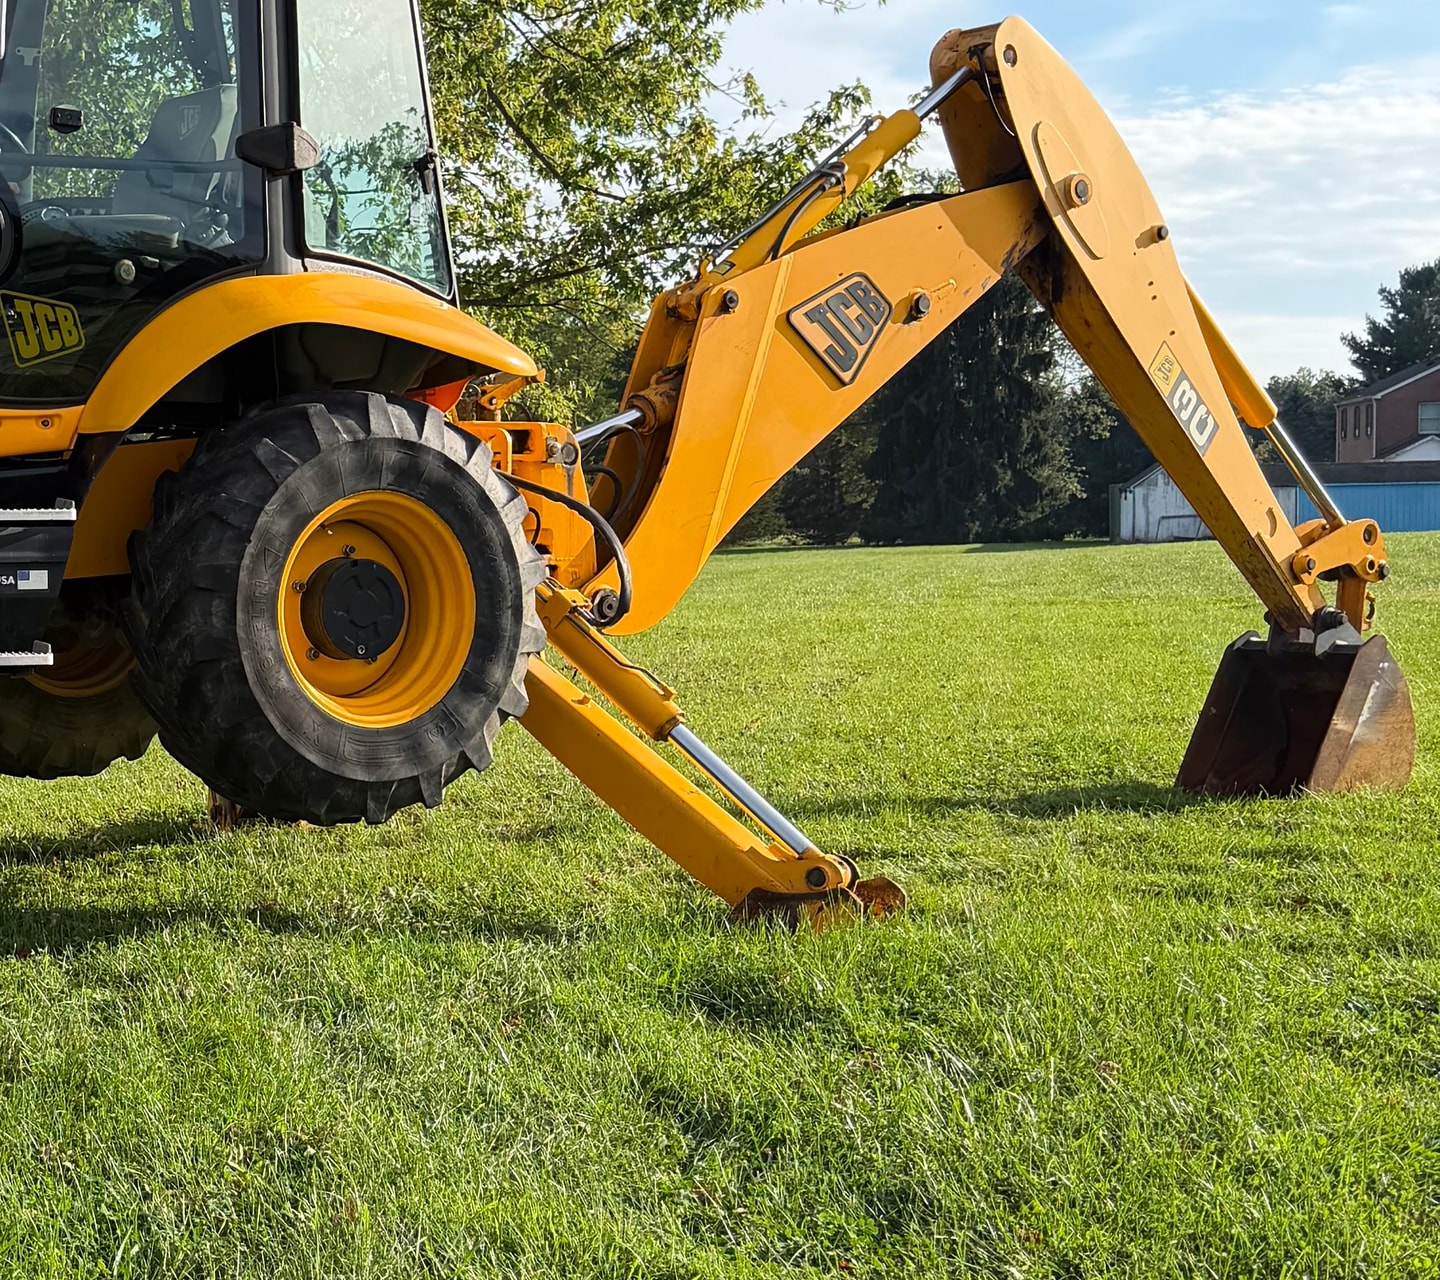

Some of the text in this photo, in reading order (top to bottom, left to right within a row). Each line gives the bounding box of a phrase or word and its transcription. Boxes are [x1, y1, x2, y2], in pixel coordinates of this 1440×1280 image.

[13, 298, 80, 359] JCB
[803, 280, 885, 373] JCB
[1157, 357, 1215, 447] JCB 3C
